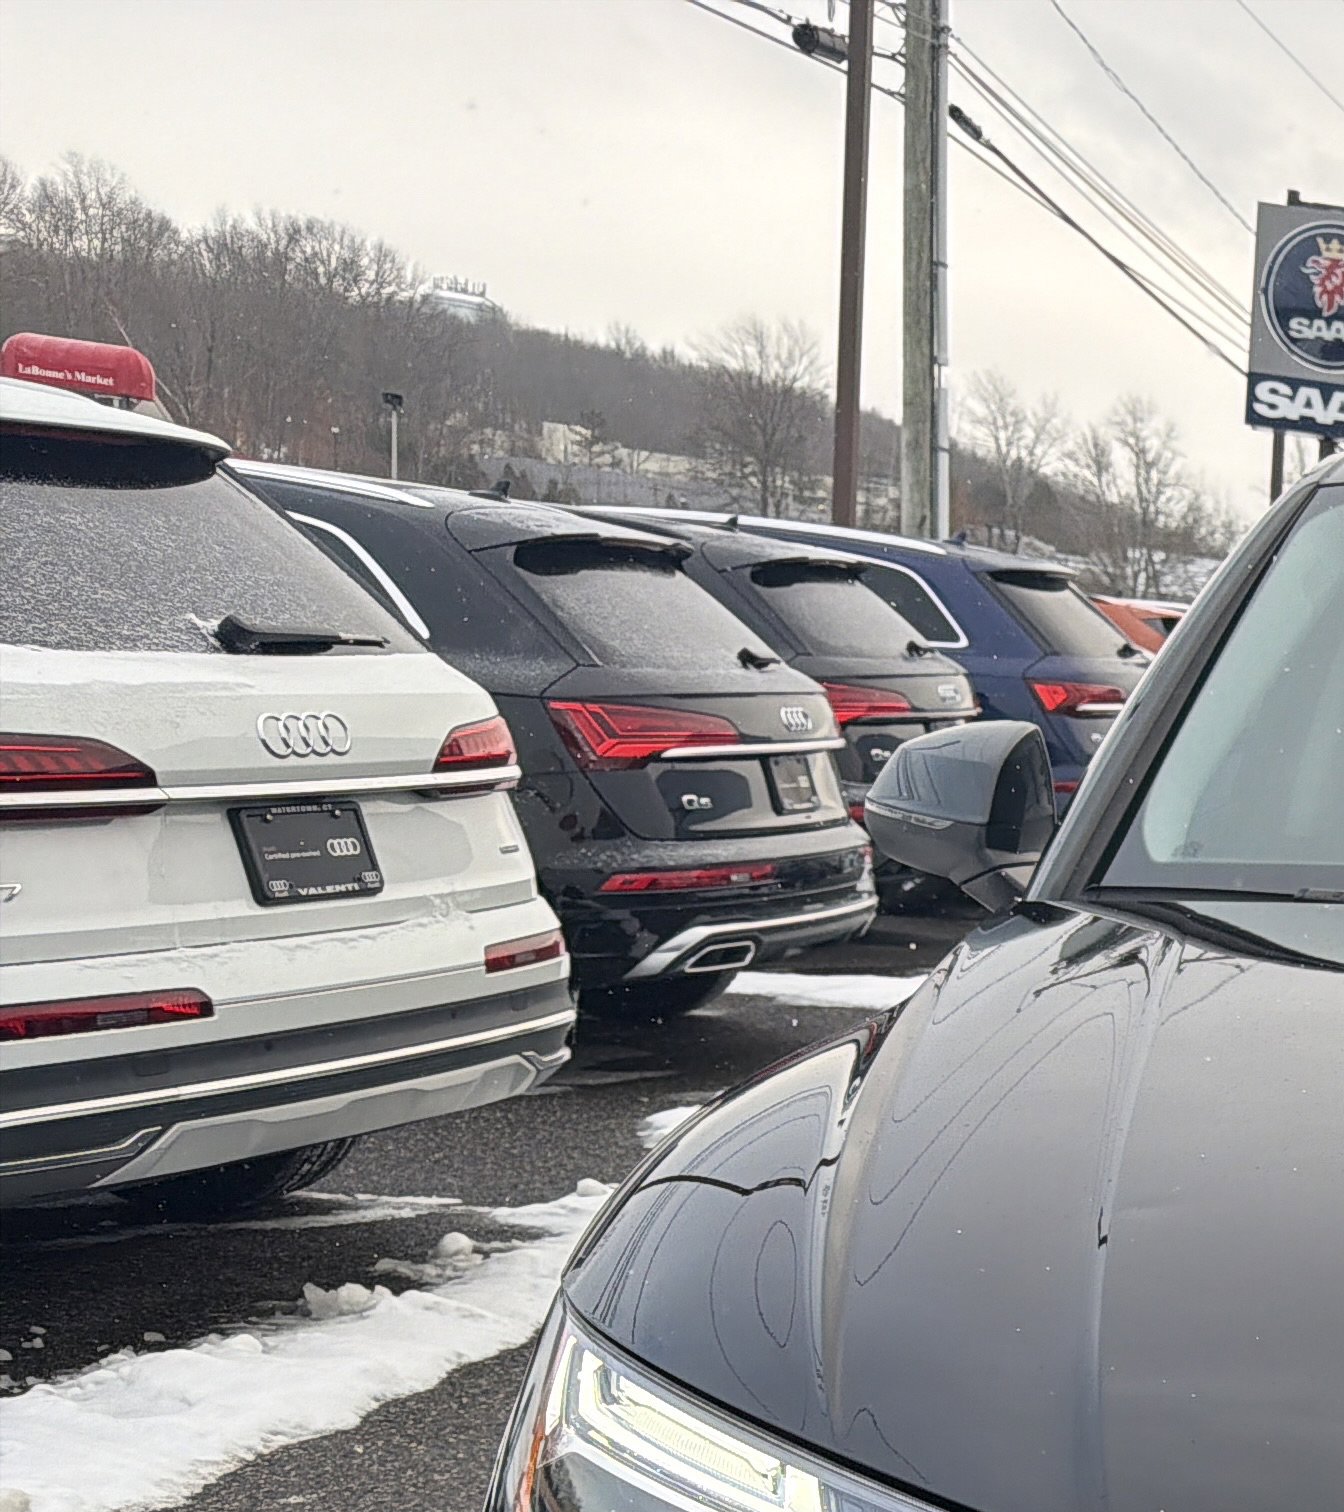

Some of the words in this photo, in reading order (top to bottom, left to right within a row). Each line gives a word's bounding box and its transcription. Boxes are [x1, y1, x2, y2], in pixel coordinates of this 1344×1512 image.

[17, 363, 73, 380] LaBonne's
[74, 370, 115, 386] Market
[298, 882, 360, 896] VALENTI
